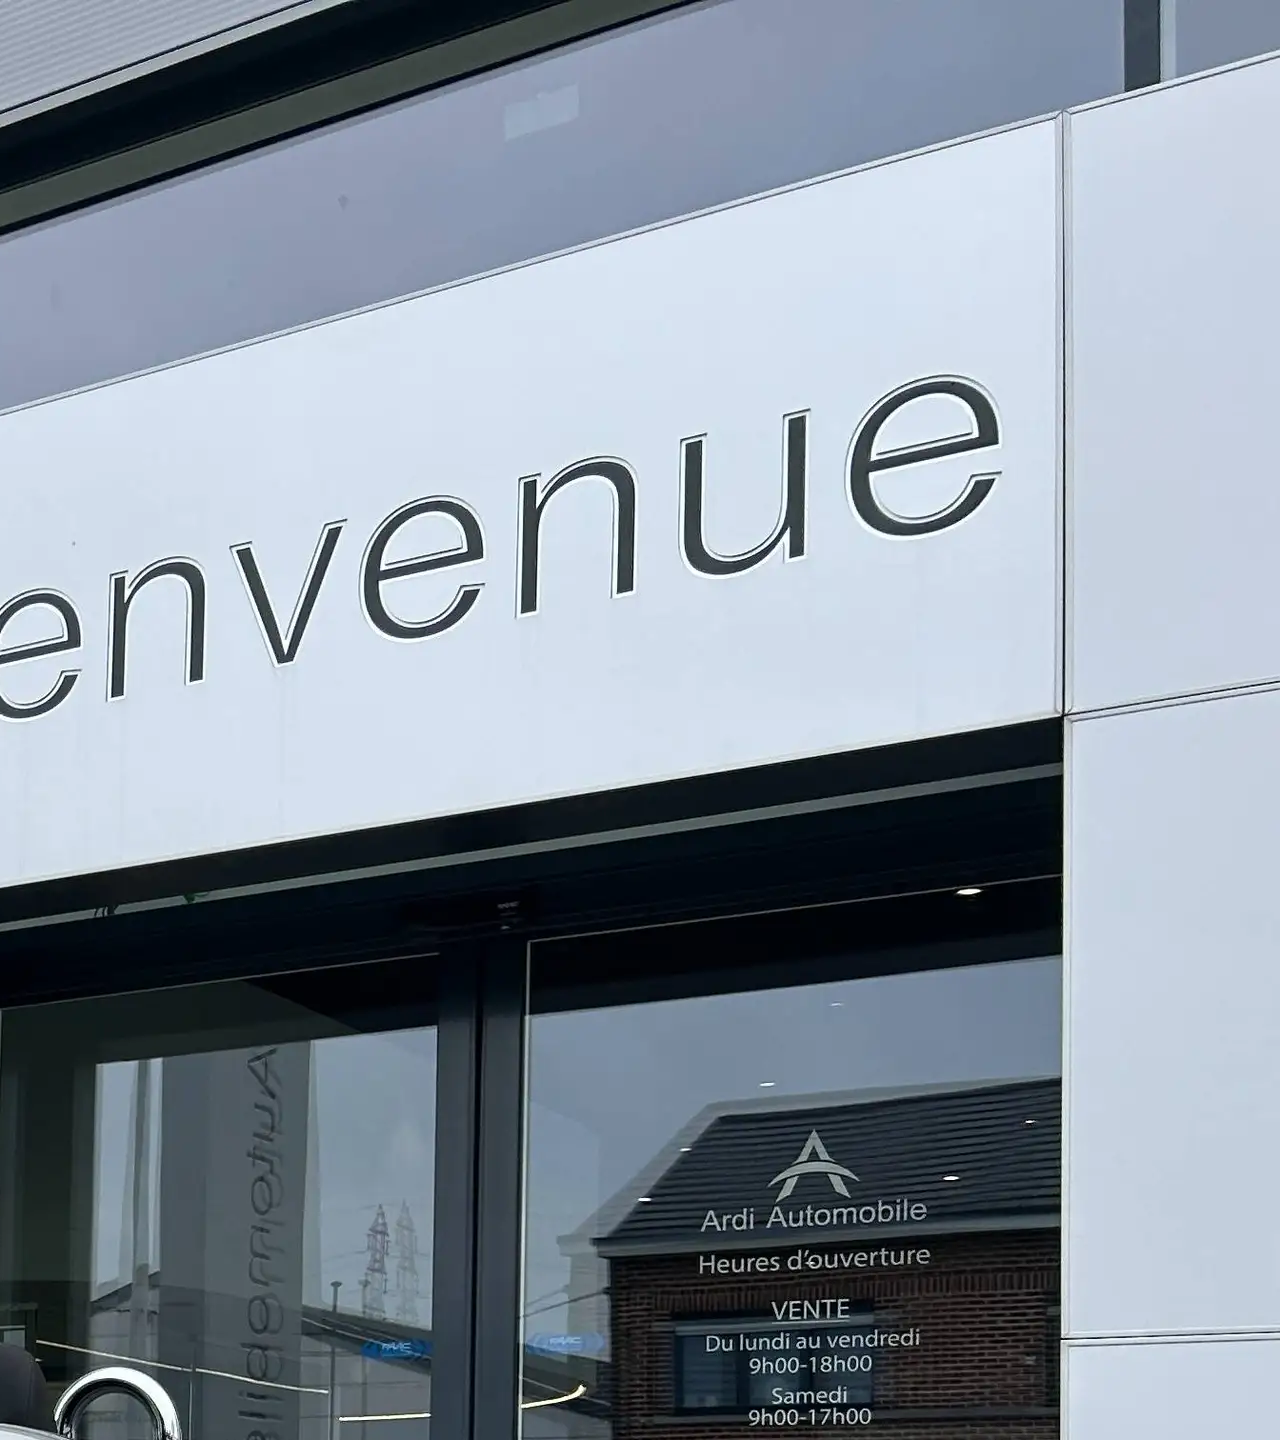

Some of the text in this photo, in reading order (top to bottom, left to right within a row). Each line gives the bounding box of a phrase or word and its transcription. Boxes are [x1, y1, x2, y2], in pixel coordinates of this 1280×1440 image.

[700, 1199, 928, 1232] Ardi Automobile
[698, 1254, 781, 1275] Heures
[771, 1298, 851, 1321] VENTE
[706, 1328, 920, 1352] Du lundi au vendredi
[749, 1355, 873, 1375] 9h00-18h00
[771, 1385, 848, 1405] Samedi
[748, 1408, 872, 1427] 9h00-17h00
